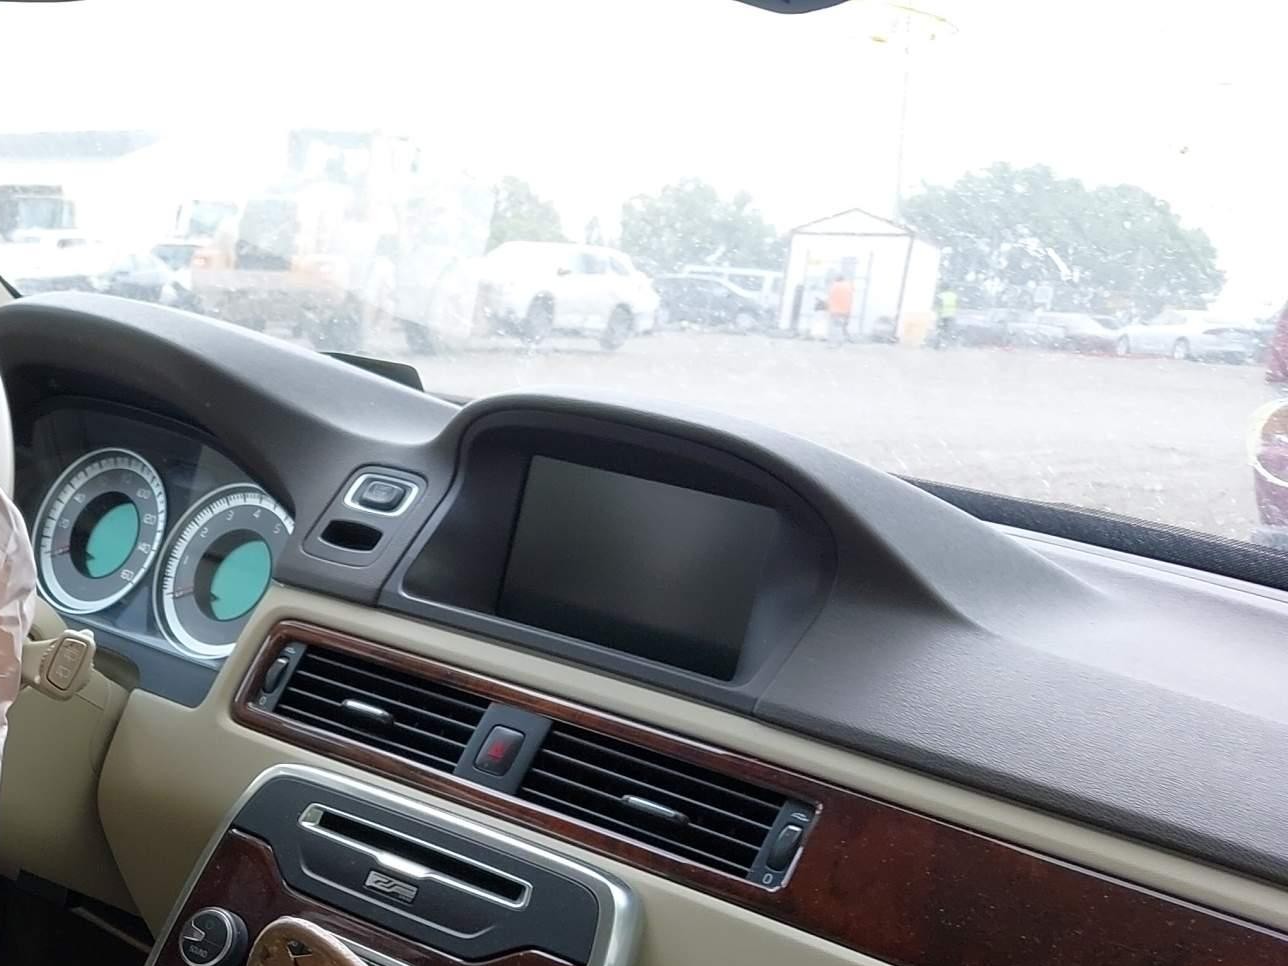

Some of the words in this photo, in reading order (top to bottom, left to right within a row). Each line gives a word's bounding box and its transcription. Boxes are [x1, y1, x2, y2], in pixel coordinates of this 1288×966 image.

[252, 509, 262, 519] 4
[200, 527, 208, 538] 2
[762, 873, 774, 885] 0
